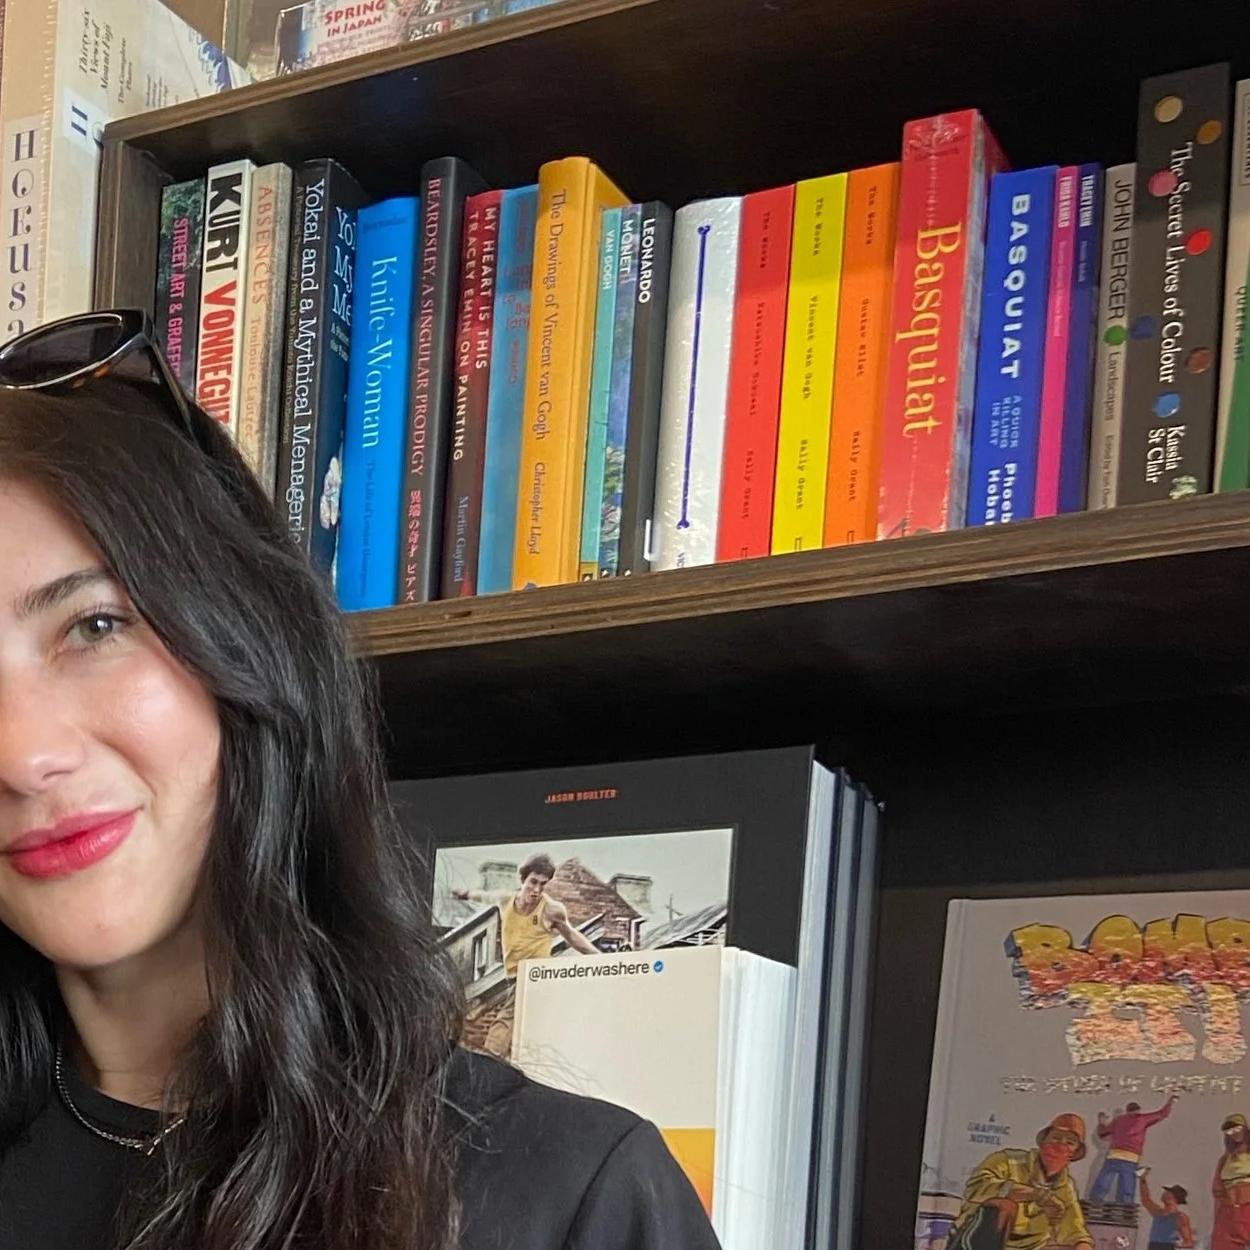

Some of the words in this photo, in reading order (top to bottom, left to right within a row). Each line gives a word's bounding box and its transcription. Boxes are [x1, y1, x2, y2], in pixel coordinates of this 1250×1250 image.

[324, 1, 386, 27] SPRING
[327, 23, 340, 37] IN
[343, 14, 383, 36] JAPAN
[1169, 141, 1194, 179] The
[206, 171, 243, 273] KURT
[422, 178, 442, 280] BEARDSLEY,
[484, 207, 497, 231] MY
[551, 188, 568, 221] The
[1111, 178, 1134, 233] JOHN
[1166, 180, 1191, 239] Secret
[464, 212, 479, 281] TRACEY
[480, 240, 495, 298] HEART
[543, 221, 564, 295] Drawings
[618, 218, 634, 275] MONET
[638, 218, 656, 304] LEONARDO
[1164, 243, 1186, 294] Lives
[421, 284, 434, 297] A
[545, 298, 560, 315] of
[999, 193, 1032, 380] BASQUIAT
[1107, 236, 1128, 322] BERGER
[461, 289, 475, 334] EMIN
[478, 305, 490, 322] IS
[893, 221, 963, 439] Basquiat
[1162, 297, 1184, 317] of
[361, 256, 398, 456] Knife-Woman
[416, 300, 434, 390] SINGULAR
[459, 341, 472, 368] ON
[476, 328, 490, 369] THIS
[541, 316, 559, 378] Vincent
[1158, 320, 1183, 384] Colour
[542, 378, 553, 402] van
[1104, 350, 1120, 423] Landscapes
[411, 393, 429, 477] PRODIGY
[453, 375, 469, 462] PAINTING
[534, 402, 553, 442] Gogh
[1147, 428, 1166, 443] St
[1145, 445, 1164, 484] Clair
[530, 462, 546, 527] Christopher
[528, 527, 543, 557] Lloyd
[528, 960, 650, 981] @invaderwashere
